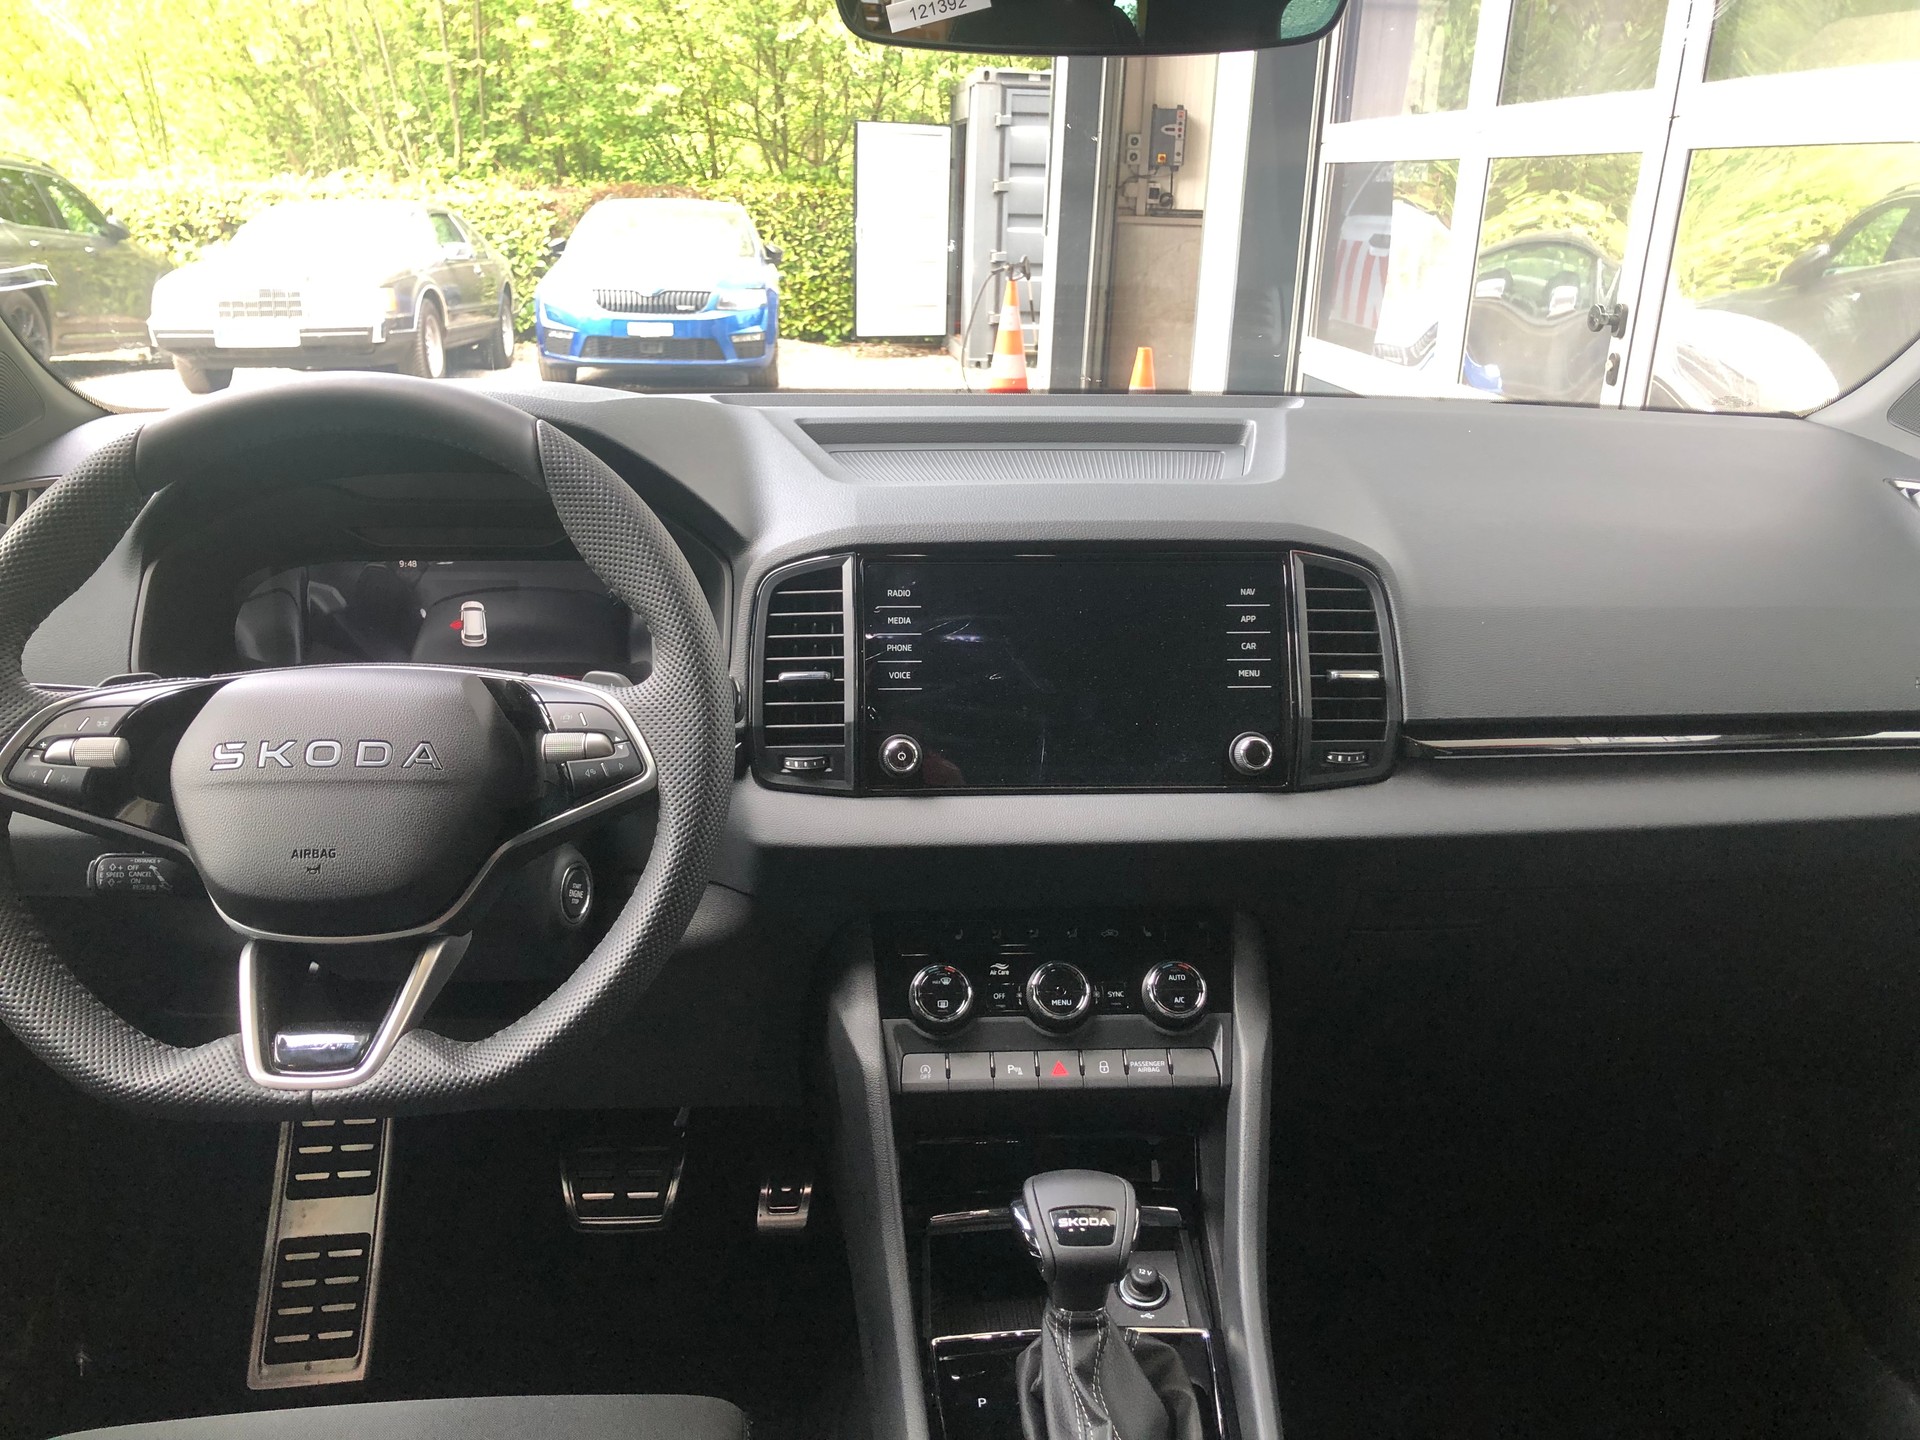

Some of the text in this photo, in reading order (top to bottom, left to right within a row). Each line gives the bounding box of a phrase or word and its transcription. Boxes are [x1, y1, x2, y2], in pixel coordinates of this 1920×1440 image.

[909, 0, 967, 21] 121392
[399, 560, 417, 568] 9:48
[887, 589, 911, 597] RADIO
[1240, 588, 1256, 596] NAV
[887, 616, 912, 625] MEDIA
[1240, 615, 1257, 623] APP
[886, 644, 912, 652] PHONE
[1241, 642, 1257, 650] CAR
[888, 671, 911, 679] VOICE
[1238, 669, 1260, 677] MENU
[210, 739, 444, 771] SKODA
[291, 848, 336, 859] AIRBAG
[1107, 990, 1125, 998] SYNC
[1174, 996, 1185, 1004] A/C
[977, 1397, 987, 1408] P
